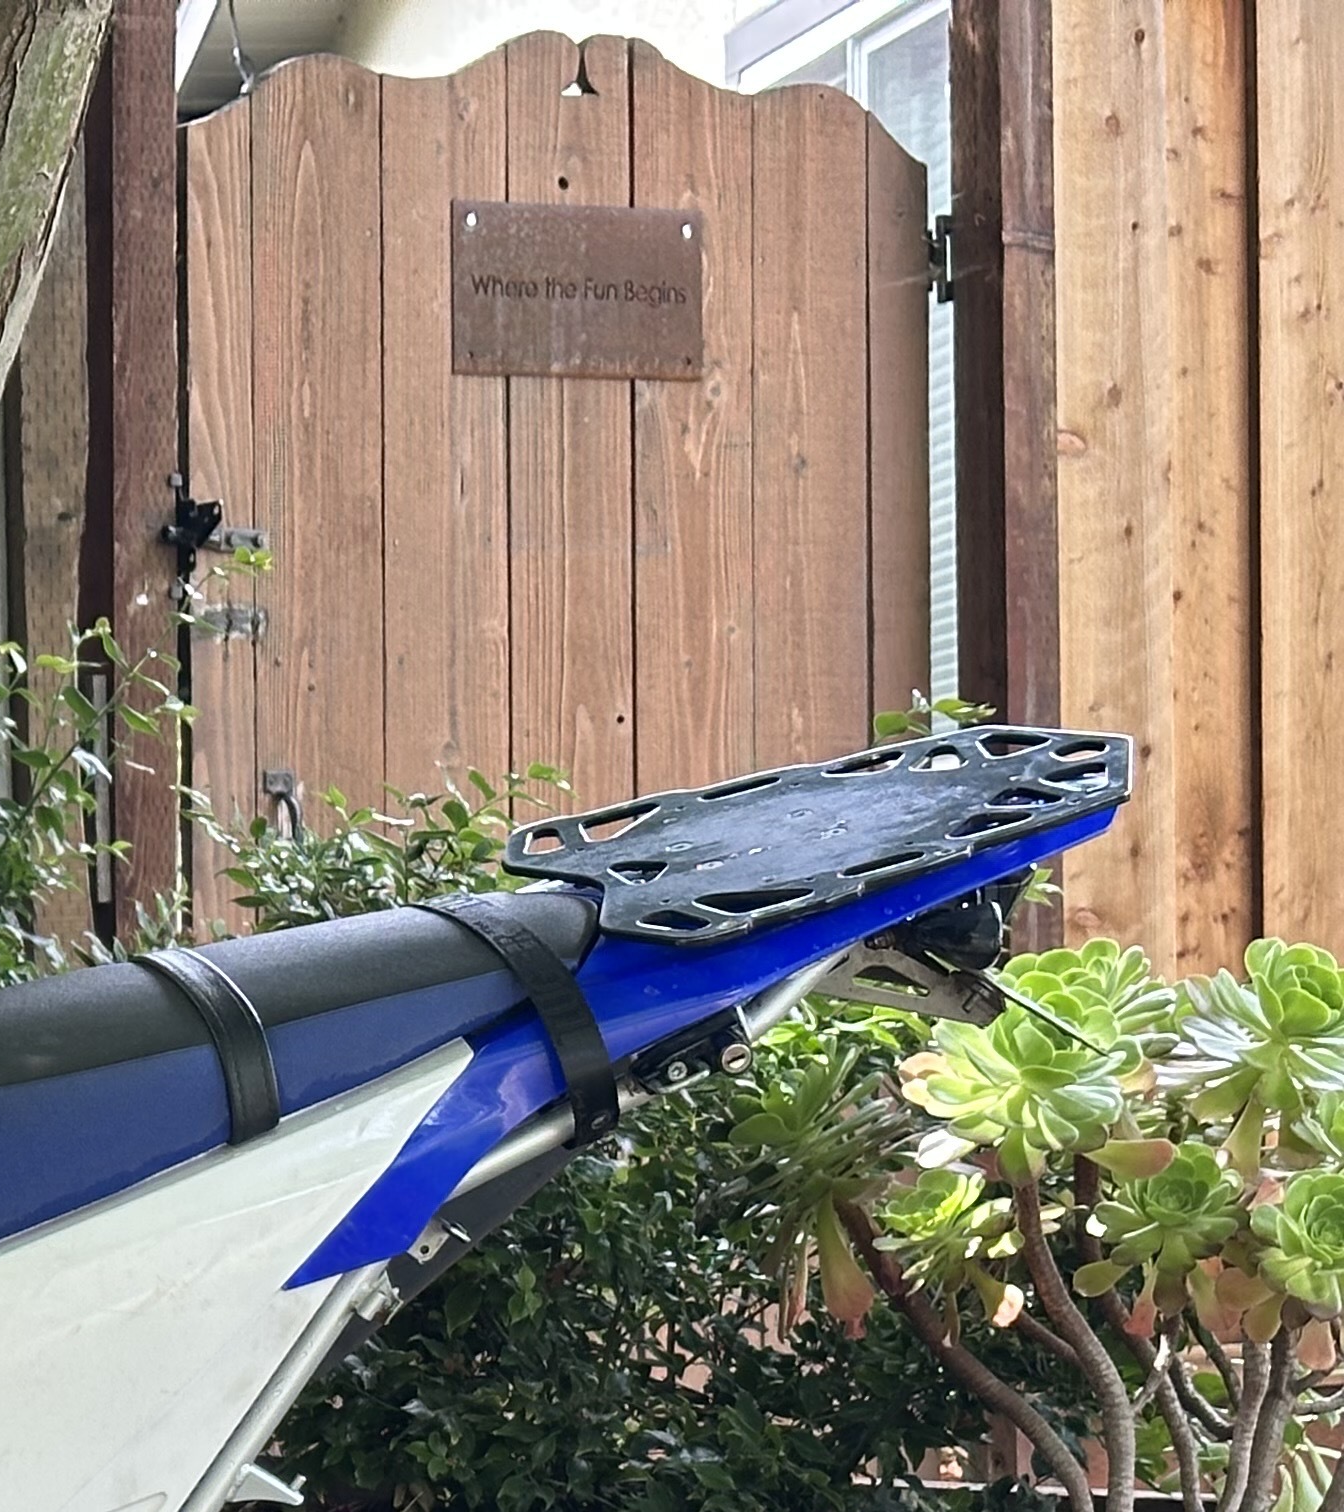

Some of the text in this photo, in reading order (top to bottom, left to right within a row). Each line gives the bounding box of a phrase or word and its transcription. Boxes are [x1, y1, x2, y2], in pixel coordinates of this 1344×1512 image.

[470, 274, 687, 308] Where the Fun Begins
